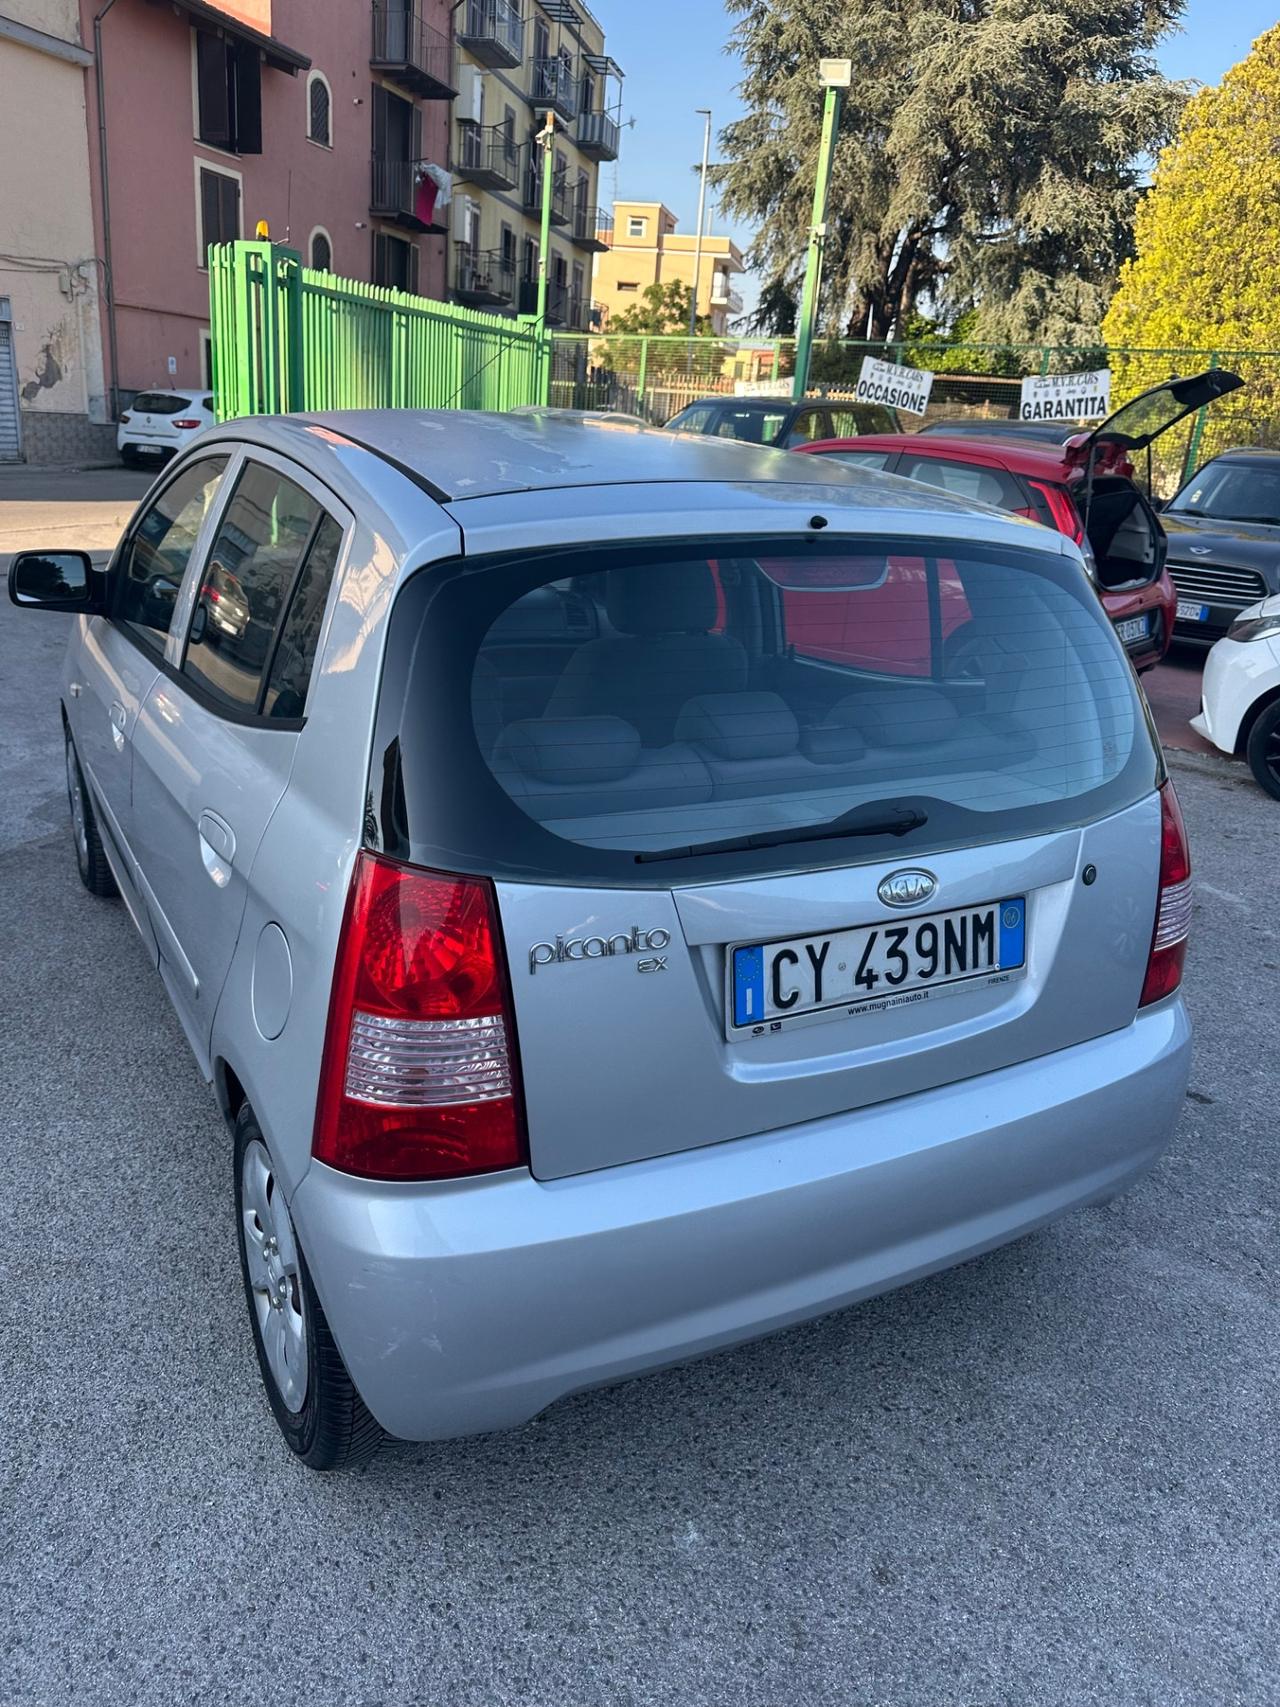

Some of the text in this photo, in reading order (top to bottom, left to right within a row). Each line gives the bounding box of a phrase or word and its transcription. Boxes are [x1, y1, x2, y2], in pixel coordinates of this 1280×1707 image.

[858, 380, 926, 413] OCCASIONE
[1022, 396, 1106, 420] GARANTITA
[884, 874, 932, 902] KIA
[529, 926, 671, 975] picanto
[638, 956, 669, 973] EX
[772, 910, 994, 1009] CY 439NM
[847, 991, 929, 1016] www.mugnainiauto.it
